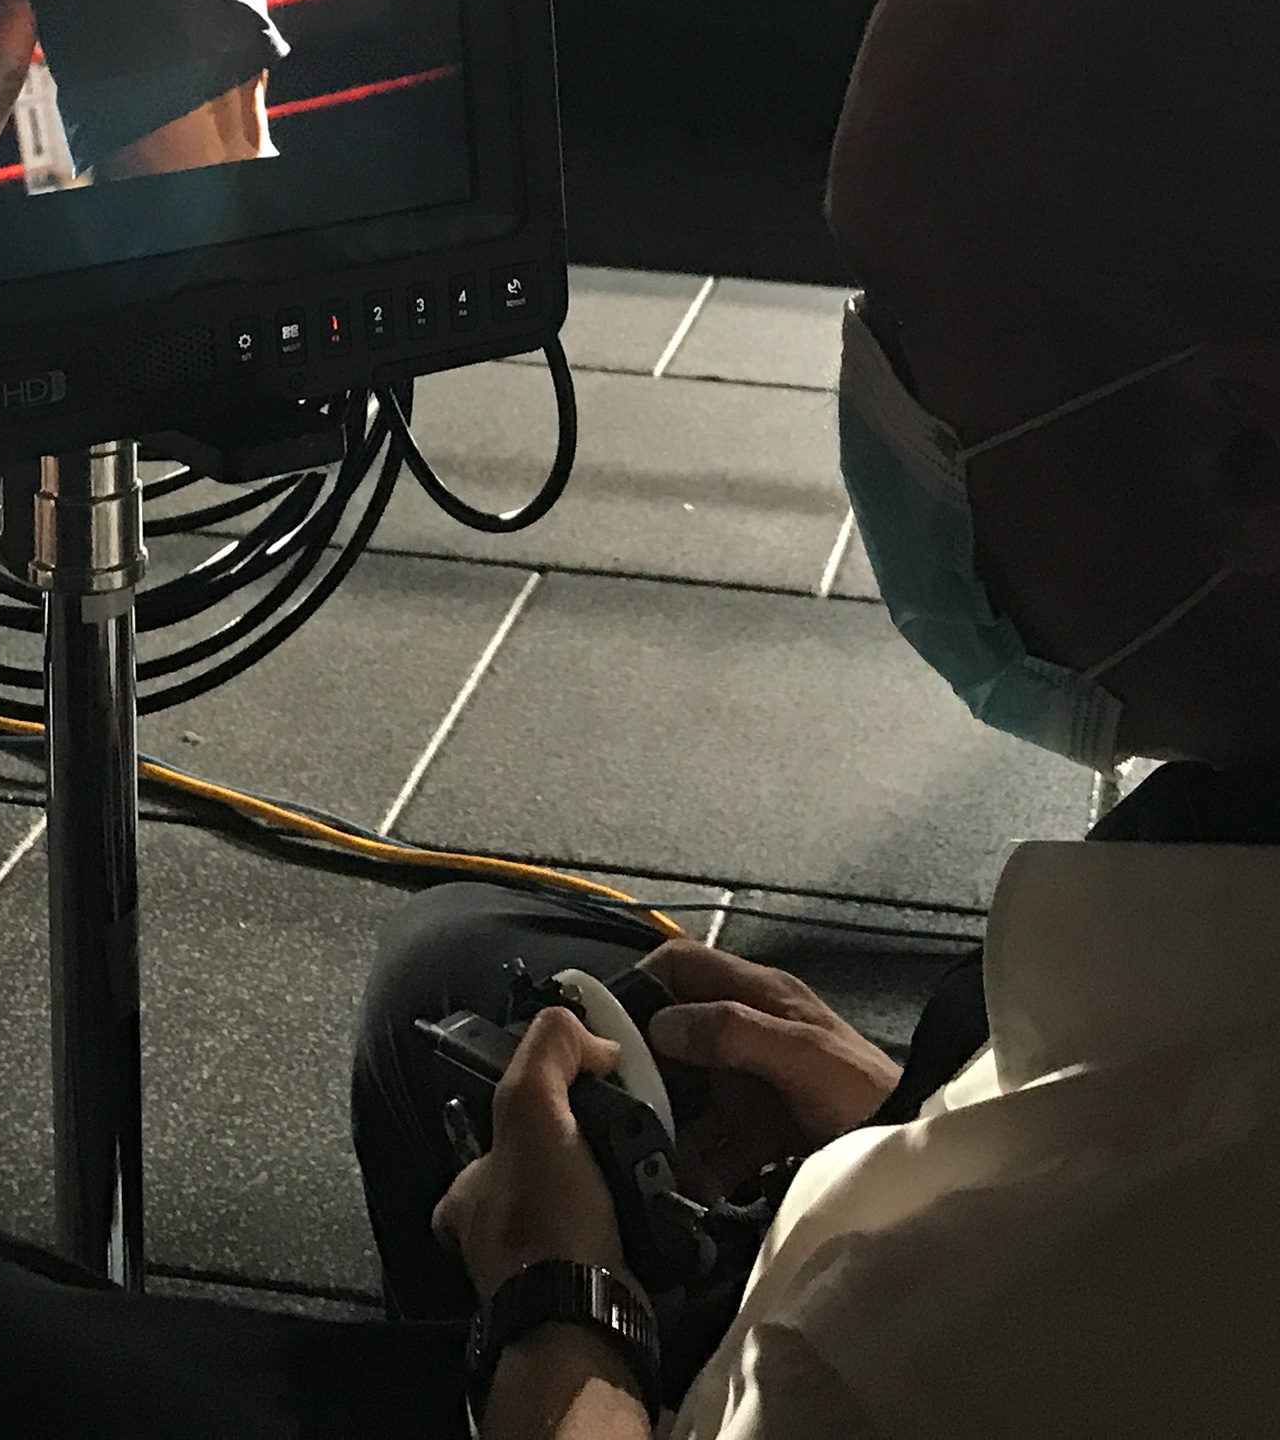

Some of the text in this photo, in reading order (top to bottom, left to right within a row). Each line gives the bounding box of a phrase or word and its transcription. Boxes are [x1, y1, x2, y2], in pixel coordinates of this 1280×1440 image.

[458, 289, 467, 303] 4
[416, 297, 425, 313] 3
[373, 306, 383, 321] 2
[331, 315, 338, 330] 1
